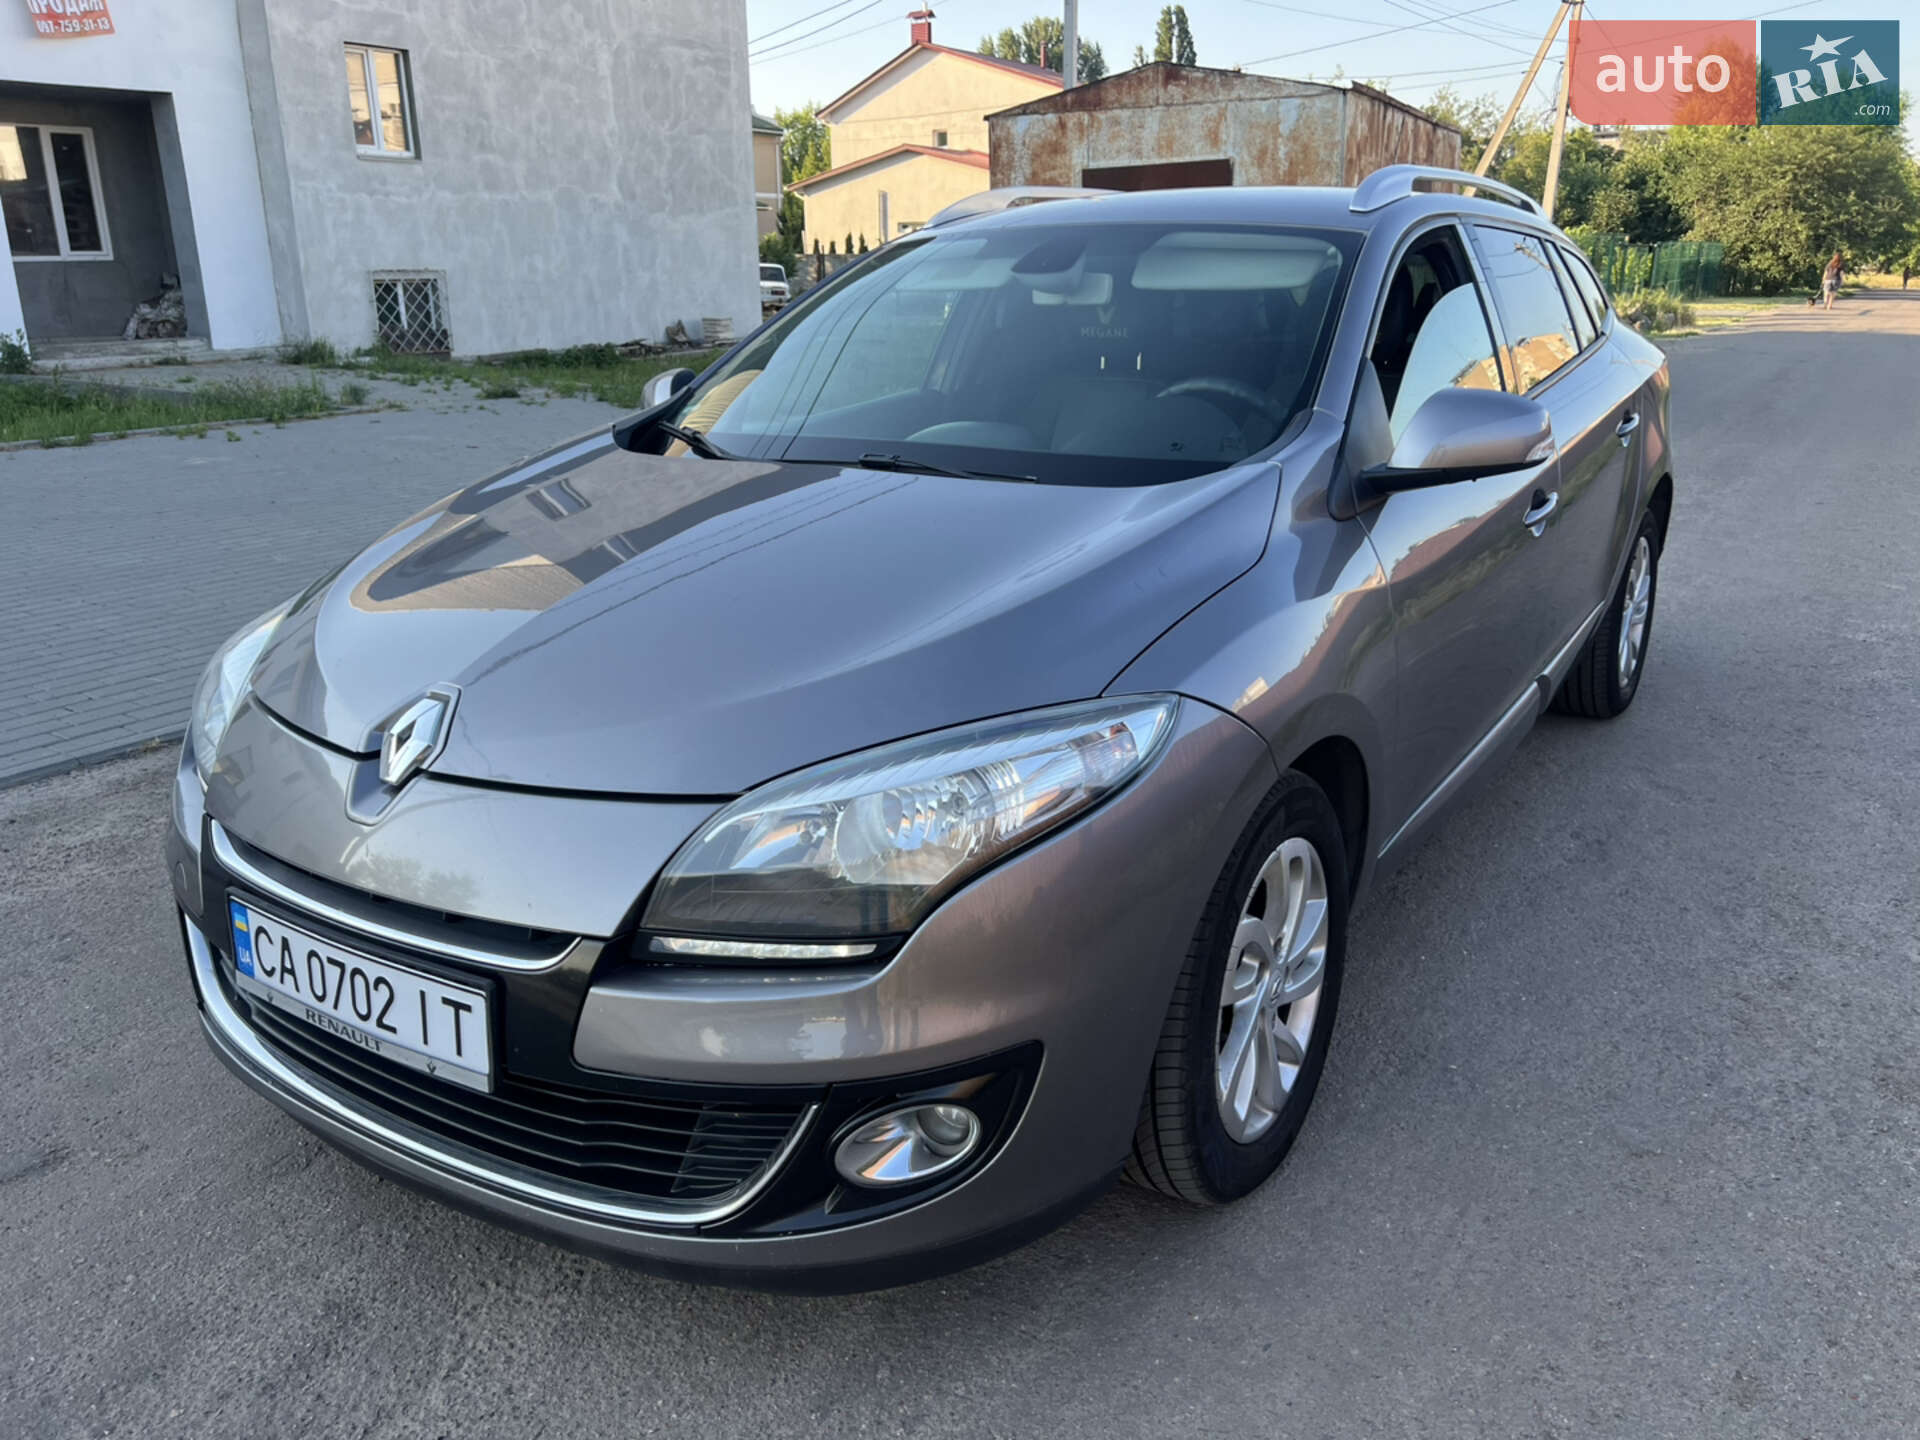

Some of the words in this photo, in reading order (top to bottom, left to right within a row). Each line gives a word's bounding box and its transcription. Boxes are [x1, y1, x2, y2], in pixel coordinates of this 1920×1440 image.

[254, 925, 300, 993] CA
[306, 949, 397, 1034] 0702
[419, 989, 472, 1057] IT
[305, 1008, 383, 1052] RENAULT
